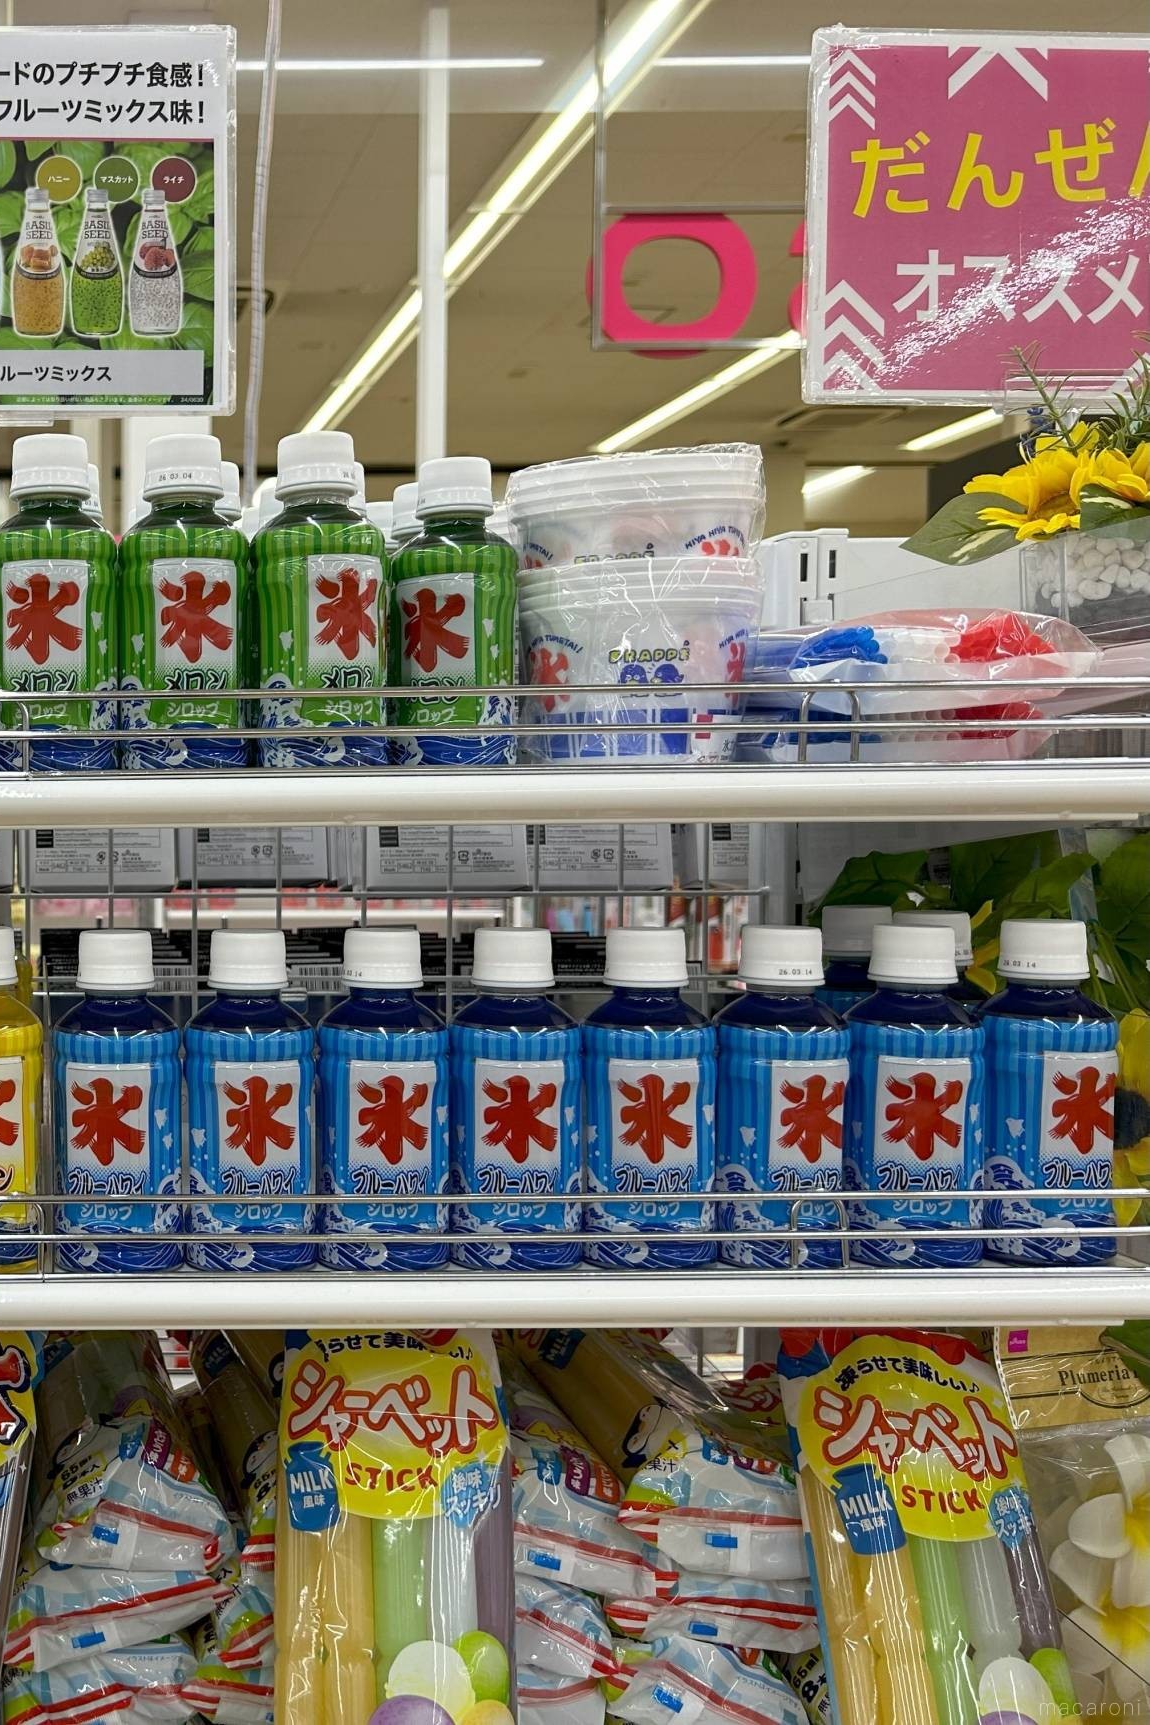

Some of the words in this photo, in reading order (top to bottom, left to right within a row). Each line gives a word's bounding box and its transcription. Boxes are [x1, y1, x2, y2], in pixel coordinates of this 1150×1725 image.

[47, 175, 71, 183] ハニー
[100, 175, 133, 183] マスカット
[163, 175, 184, 184] ライチ
[26, 230, 53, 239] SEED
[84, 221, 111, 230] BASIL
[84, 230, 111, 239] SEED
[142, 221, 168, 230] BASIL
[142, 230, 169, 239] SEED
[5, 573, 83, 665] 氷
[158, 570, 233, 663] 氷
[313, 568, 377, 660] 氷
[402, 588, 470, 673] 氷
[166, 701, 219, 717] シロップ
[778, 968, 813, 976] 26.03.14
[70, 1076, 146, 1166] 氷
[223, 1075, 296, 1166] 氷
[356, 1075, 429, 1165] 氷
[481, 1074, 558, 1164] 氷
[617, 1073, 693, 1163] 氷
[776, 1074, 845, 1163] 氷
[882, 1071, 963, 1161] 氷
[1048, 1066, 1116, 1155] 氷
[78, 1203, 133, 1221] シロップ
[235, 1203, 283, 1220] シロップ
[367, 1202, 419, 1219] シロップ
[493, 1201, 548, 1218] シロップ
[629, 1201, 681, 1217] シロップ
[1058, 1365, 1130, 1386] Plumeria
[288, 1358, 499, 1454] シャーベット
[814, 1386, 1018, 1481] シャーベット
[290, 1472, 334, 1494] MILK
[345, 1462, 438, 1494] STICK
[452, 1467, 483, 1493] 後味
[303, 1493, 326, 1508] 風味
[840, 1489, 894, 1520] MILK
[902, 1485, 985, 1514] STICK
